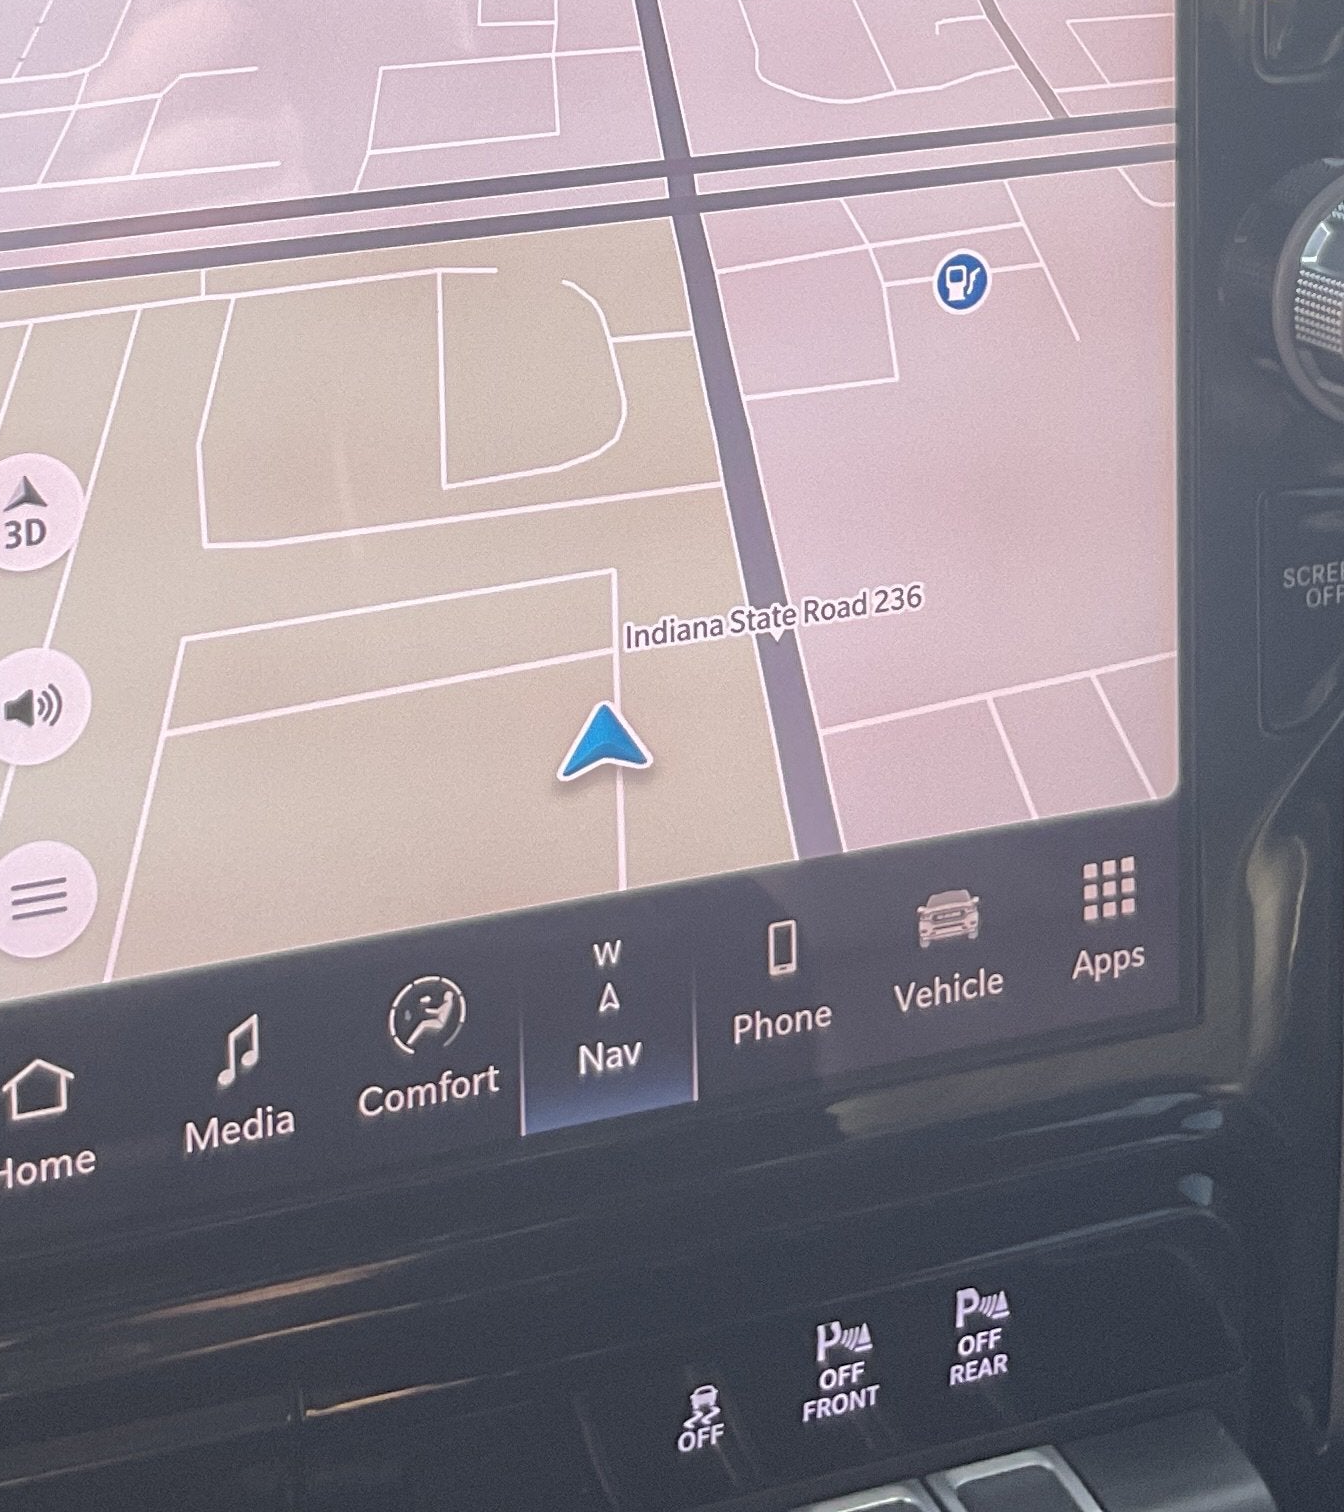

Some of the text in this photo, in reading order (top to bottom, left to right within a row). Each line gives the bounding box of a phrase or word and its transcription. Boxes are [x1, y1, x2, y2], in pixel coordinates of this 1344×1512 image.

[4, 518, 47, 550] 3D
[626, 584, 924, 650] Indiana State Road 236
[592, 939, 623, 966] W
[1071, 942, 1146, 983] Apps
[894, 968, 1005, 1013] Vehicle
[733, 1004, 834, 1045] Phone
[578, 1040, 644, 1076] Nav
[358, 1064, 501, 1118] Comfort
[184, 1104, 297, 1155] Media
[957, 1327, 1002, 1359] OFF
[819, 1361, 865, 1391] OFF
[949, 1352, 1009, 1387] REAR
[802, 1384, 881, 1423] FRONT
[677, 1422, 724, 1453] OFF
